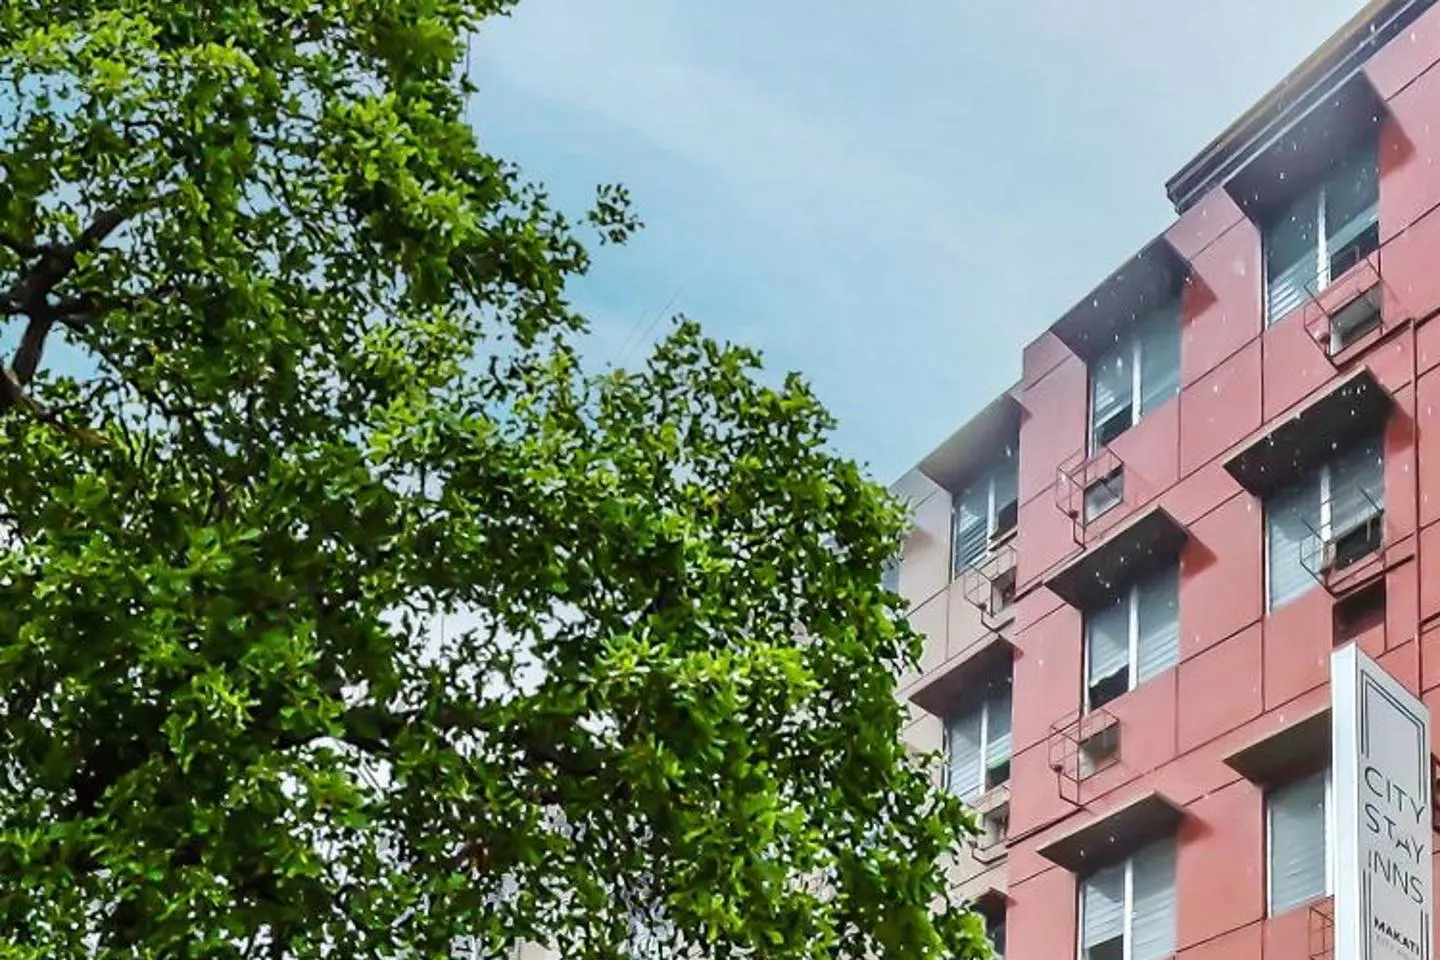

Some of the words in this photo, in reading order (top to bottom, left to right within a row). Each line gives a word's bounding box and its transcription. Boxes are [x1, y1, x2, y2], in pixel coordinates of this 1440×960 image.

[1364, 765, 1425, 824] CITY
[1364, 803, 1424, 865] STAY
[1367, 850, 1424, 904] INNS
[1374, 916, 1420, 956] MAKATI
